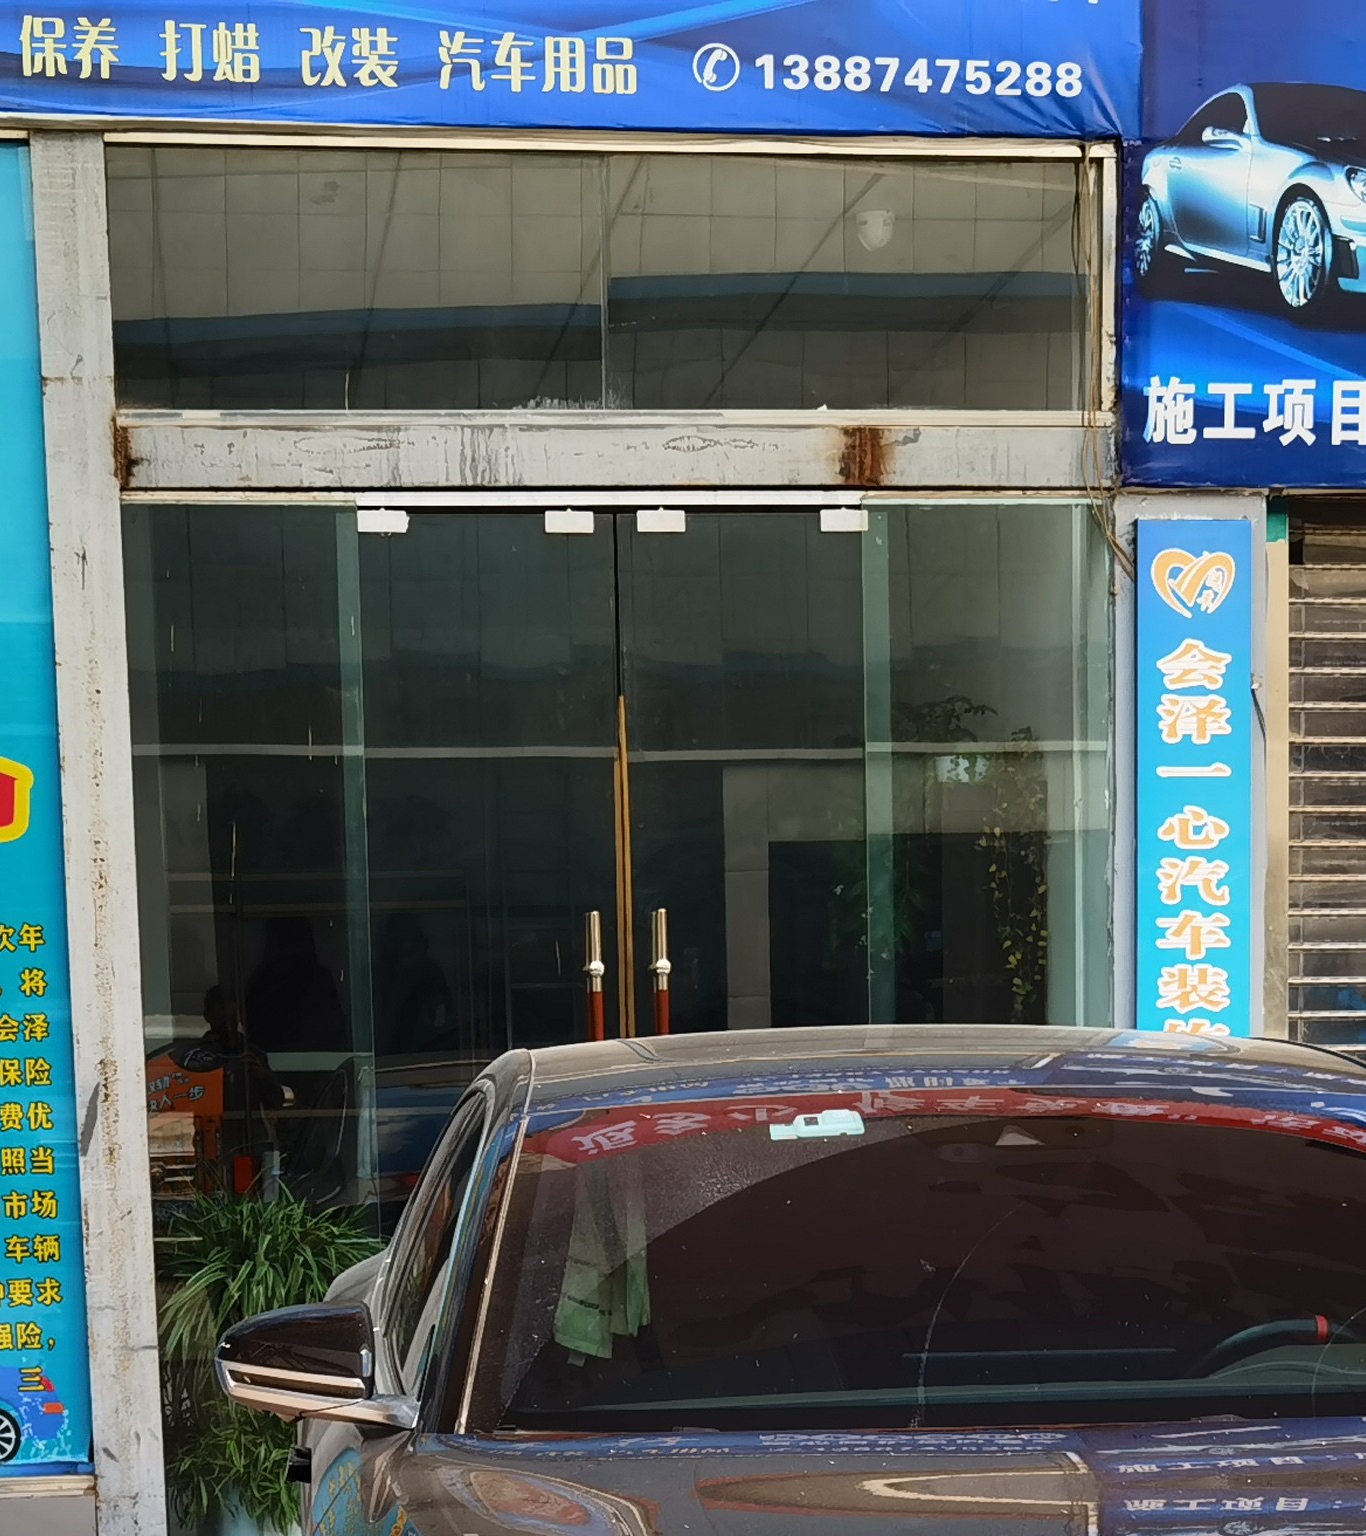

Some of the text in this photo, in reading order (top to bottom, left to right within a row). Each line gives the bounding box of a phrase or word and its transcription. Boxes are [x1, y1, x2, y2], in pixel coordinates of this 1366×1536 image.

[20, 14, 120, 79] 保养
[161, 19, 261, 86] 打蜡
[299, 26, 400, 90] 改装
[437, 31, 639, 96] 汽车用品
[754, 53, 1083, 99] 13887475288
